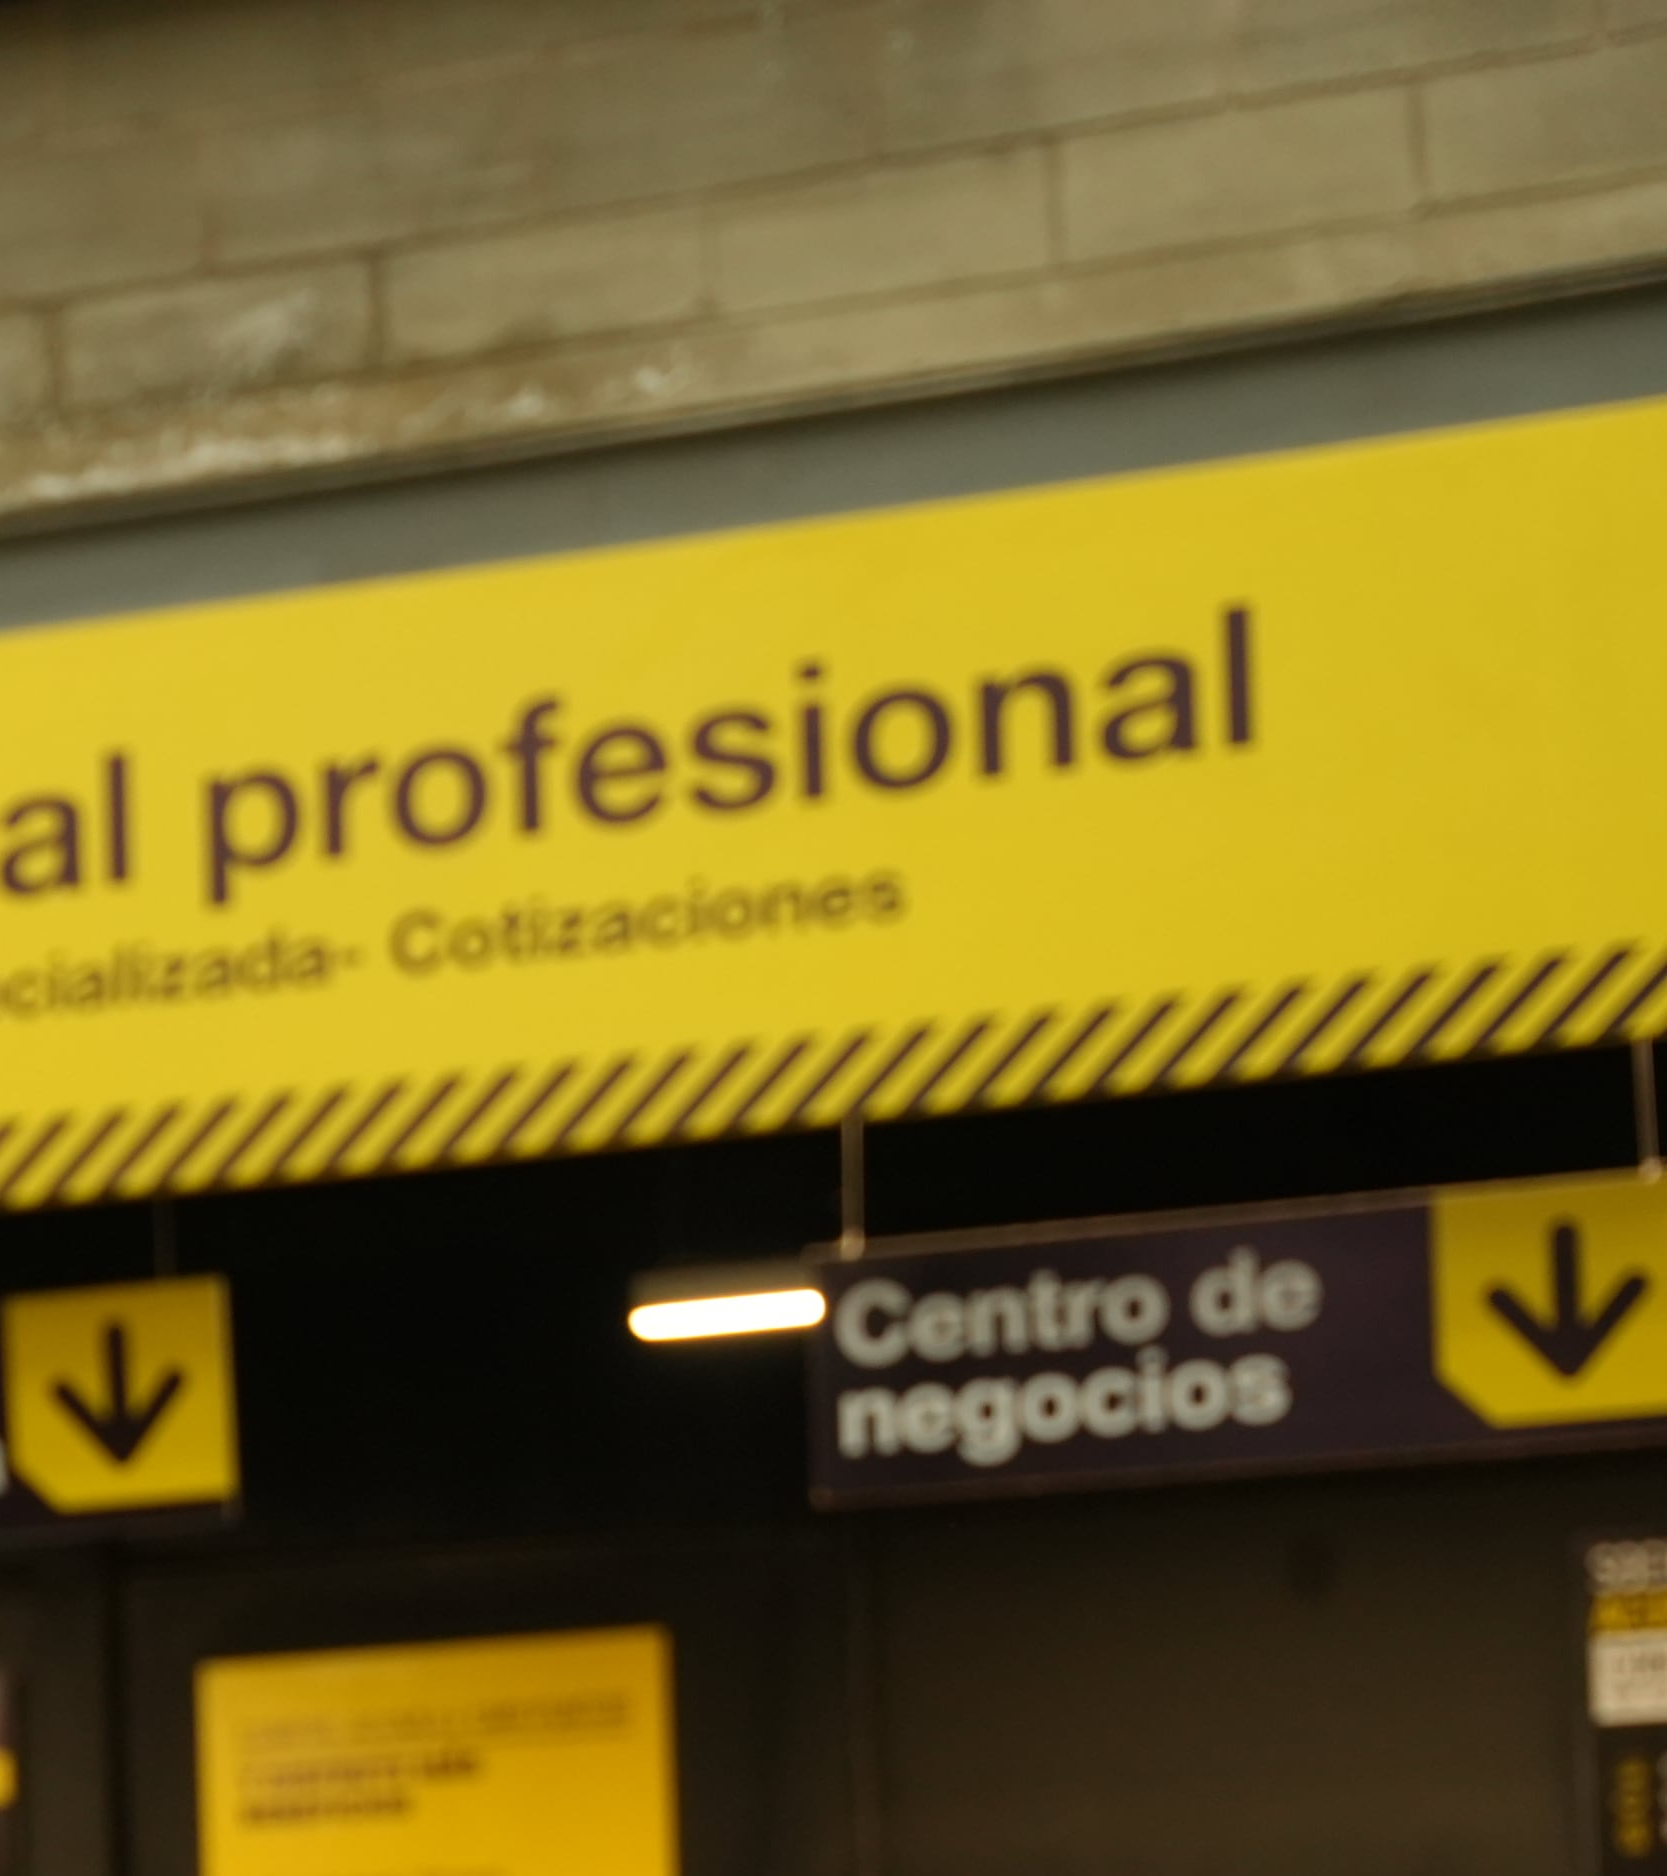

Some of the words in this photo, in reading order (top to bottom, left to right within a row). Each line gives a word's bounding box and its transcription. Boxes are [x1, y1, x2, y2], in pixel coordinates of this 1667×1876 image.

[204, 600, 1256, 910] profesional
[389, 866, 907, 976] Cotizaciones
[833, 1266, 1171, 1368] Centro
[1189, 1246, 1324, 1337] de
[836, 1344, 1293, 1467] negocios
